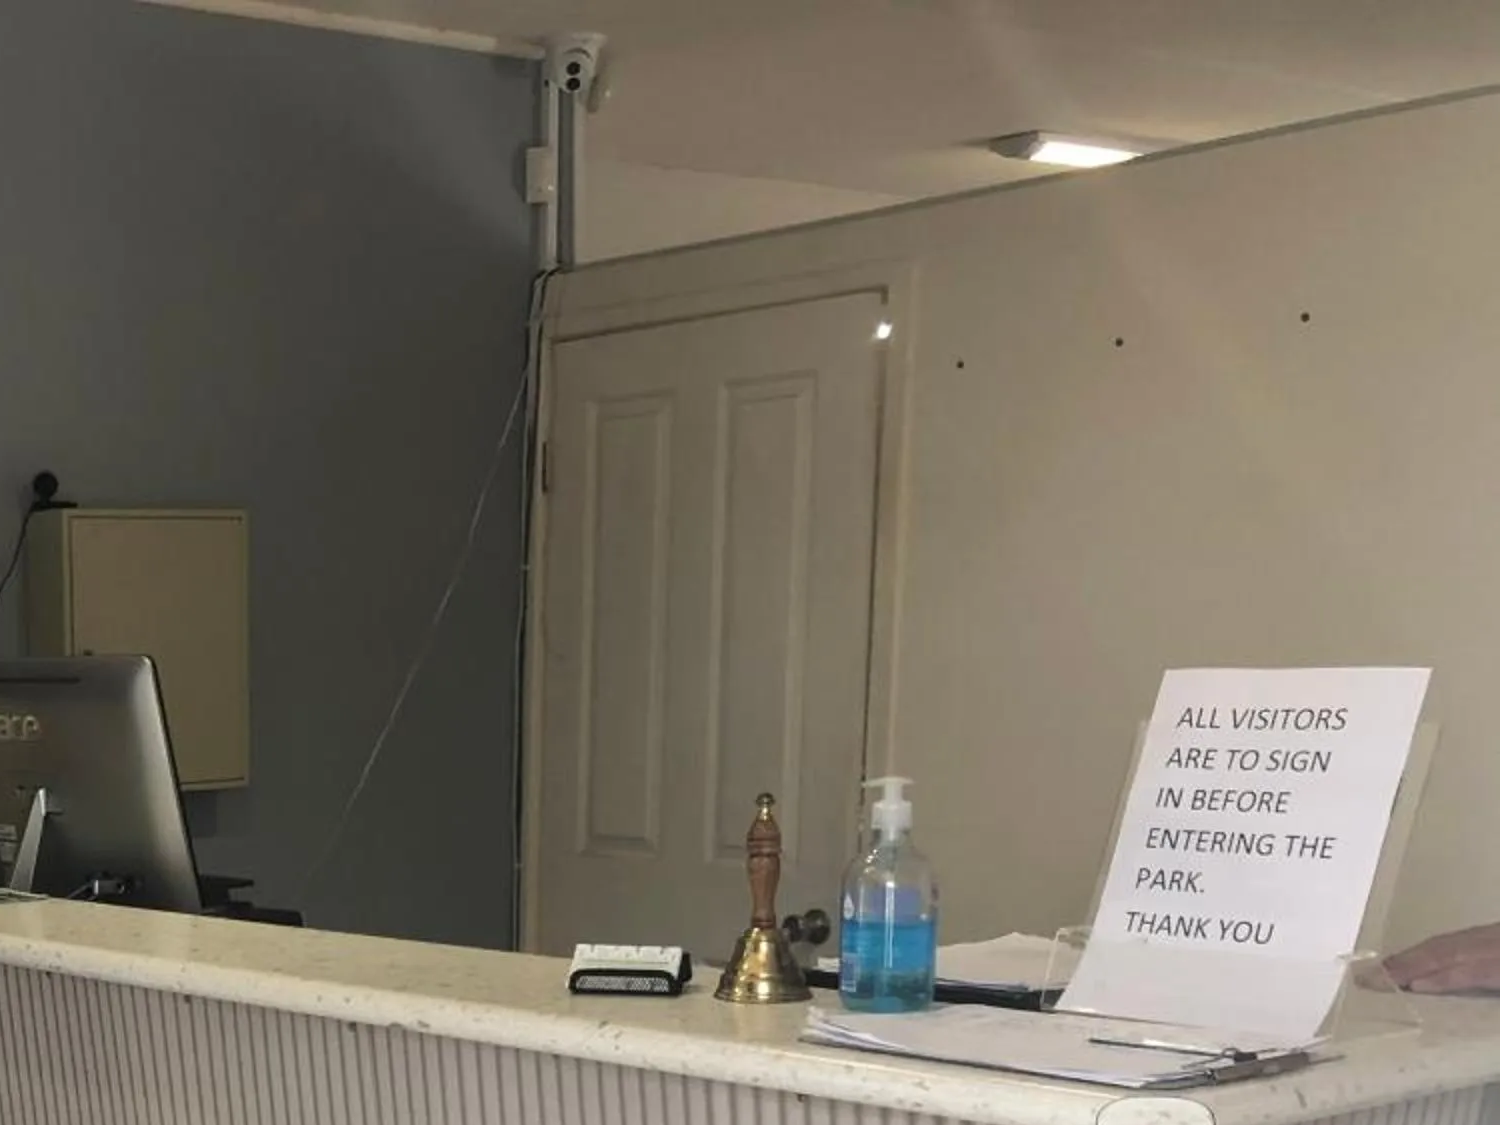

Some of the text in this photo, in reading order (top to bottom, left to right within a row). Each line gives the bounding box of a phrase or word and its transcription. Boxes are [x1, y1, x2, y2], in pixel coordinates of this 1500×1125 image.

[1177, 707, 1348, 731] ALL VISITORS
[1166, 748, 1331, 773] ARE TO SIGN
[1155, 787, 1291, 814] IN BEFORE
[1145, 827, 1336, 860] ENTERING THE
[1135, 868, 1204, 894] PARK.
[1124, 911, 1274, 945] THANK YOU
